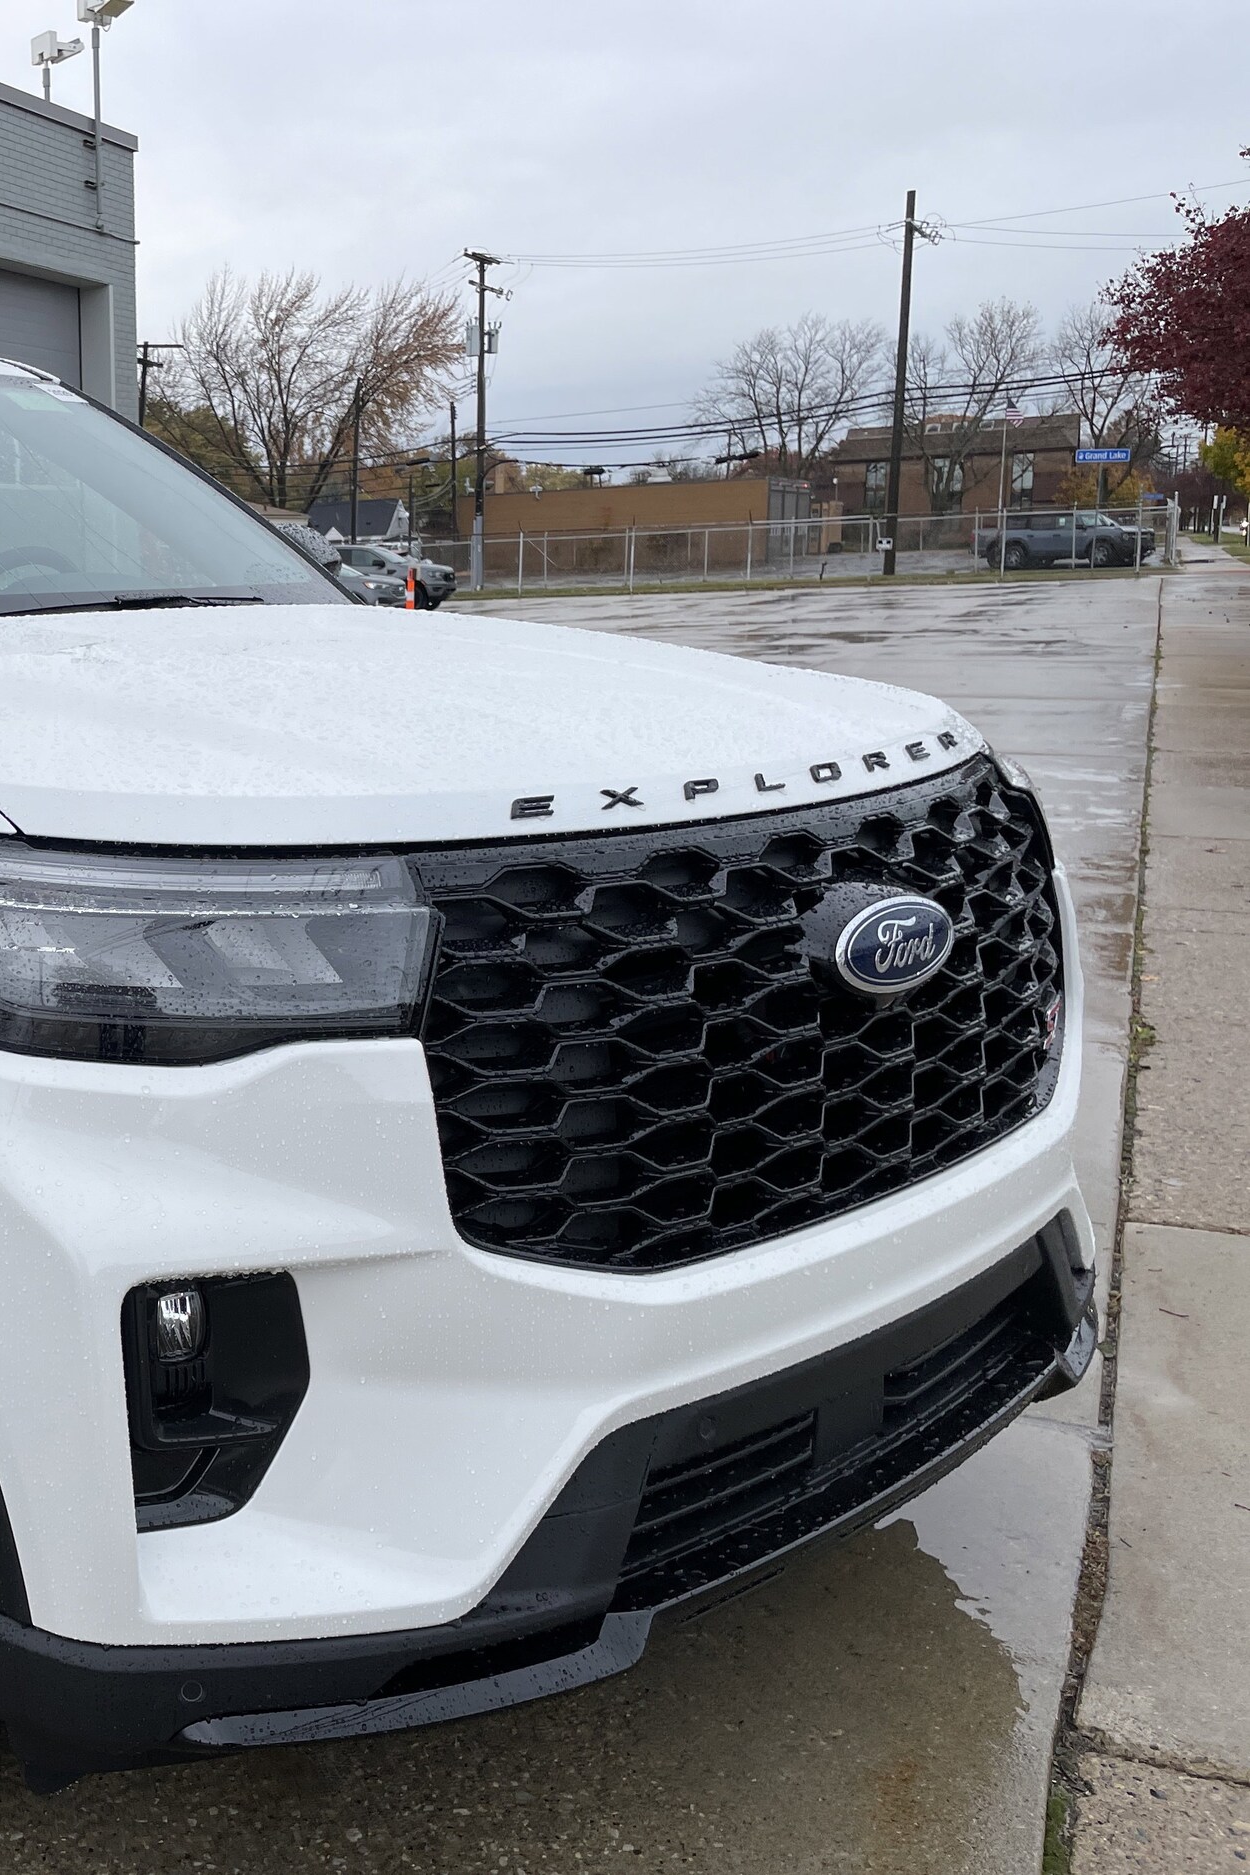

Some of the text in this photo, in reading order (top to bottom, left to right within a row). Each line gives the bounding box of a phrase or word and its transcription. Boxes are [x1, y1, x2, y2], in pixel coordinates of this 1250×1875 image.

[1085, 452, 1107, 460] Grand
[511, 731, 958, 819] EXPLORER
[875, 915, 935, 973] Ford
